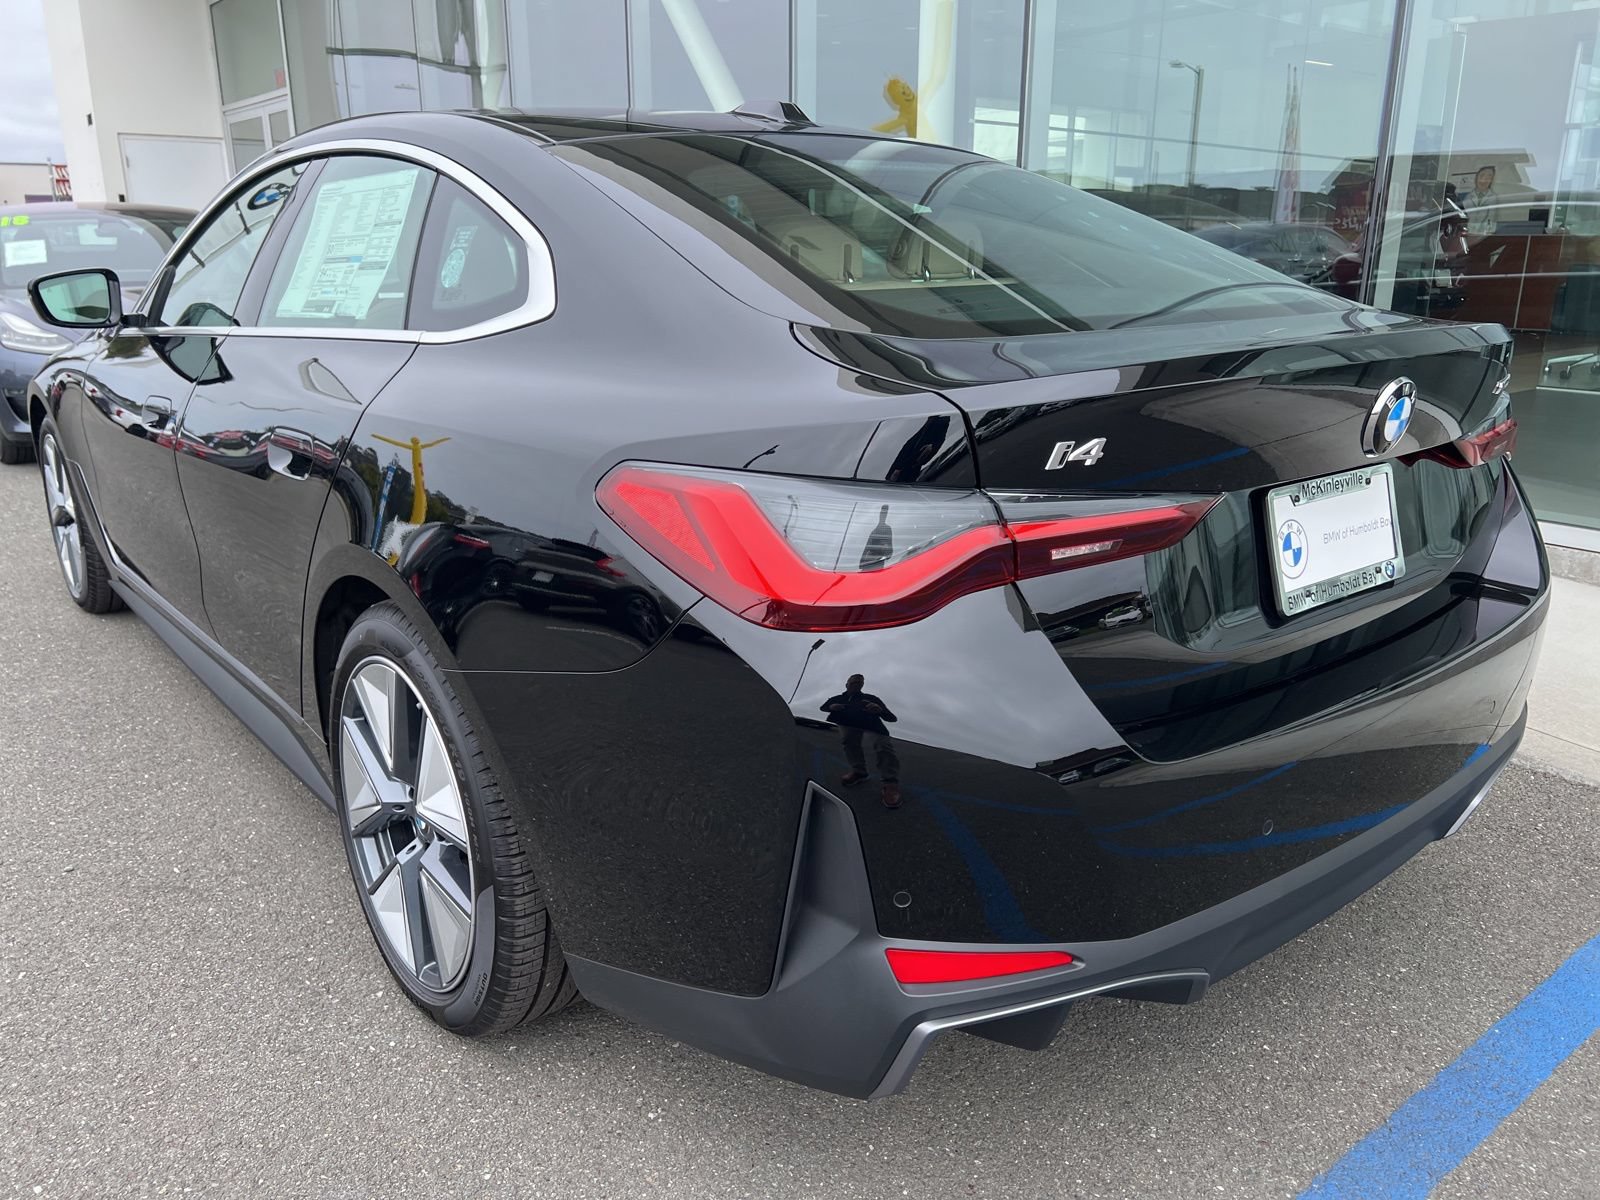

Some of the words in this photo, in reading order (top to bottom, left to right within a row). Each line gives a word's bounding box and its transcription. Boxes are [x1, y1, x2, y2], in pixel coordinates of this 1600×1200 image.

[1045, 437, 1107, 470] i4
[1301, 472, 1363, 498] McKinleyville
[1323, 529, 1340, 544] BMW
[1342, 527, 1349, 539] of
[1350, 519, 1379, 536] Humboldt
[1288, 591, 1307, 610] BMW
[1310, 585, 1320, 602] of
[1320, 575, 1361, 598] Humboldt
[1361, 570, 1378, 586] Bay
